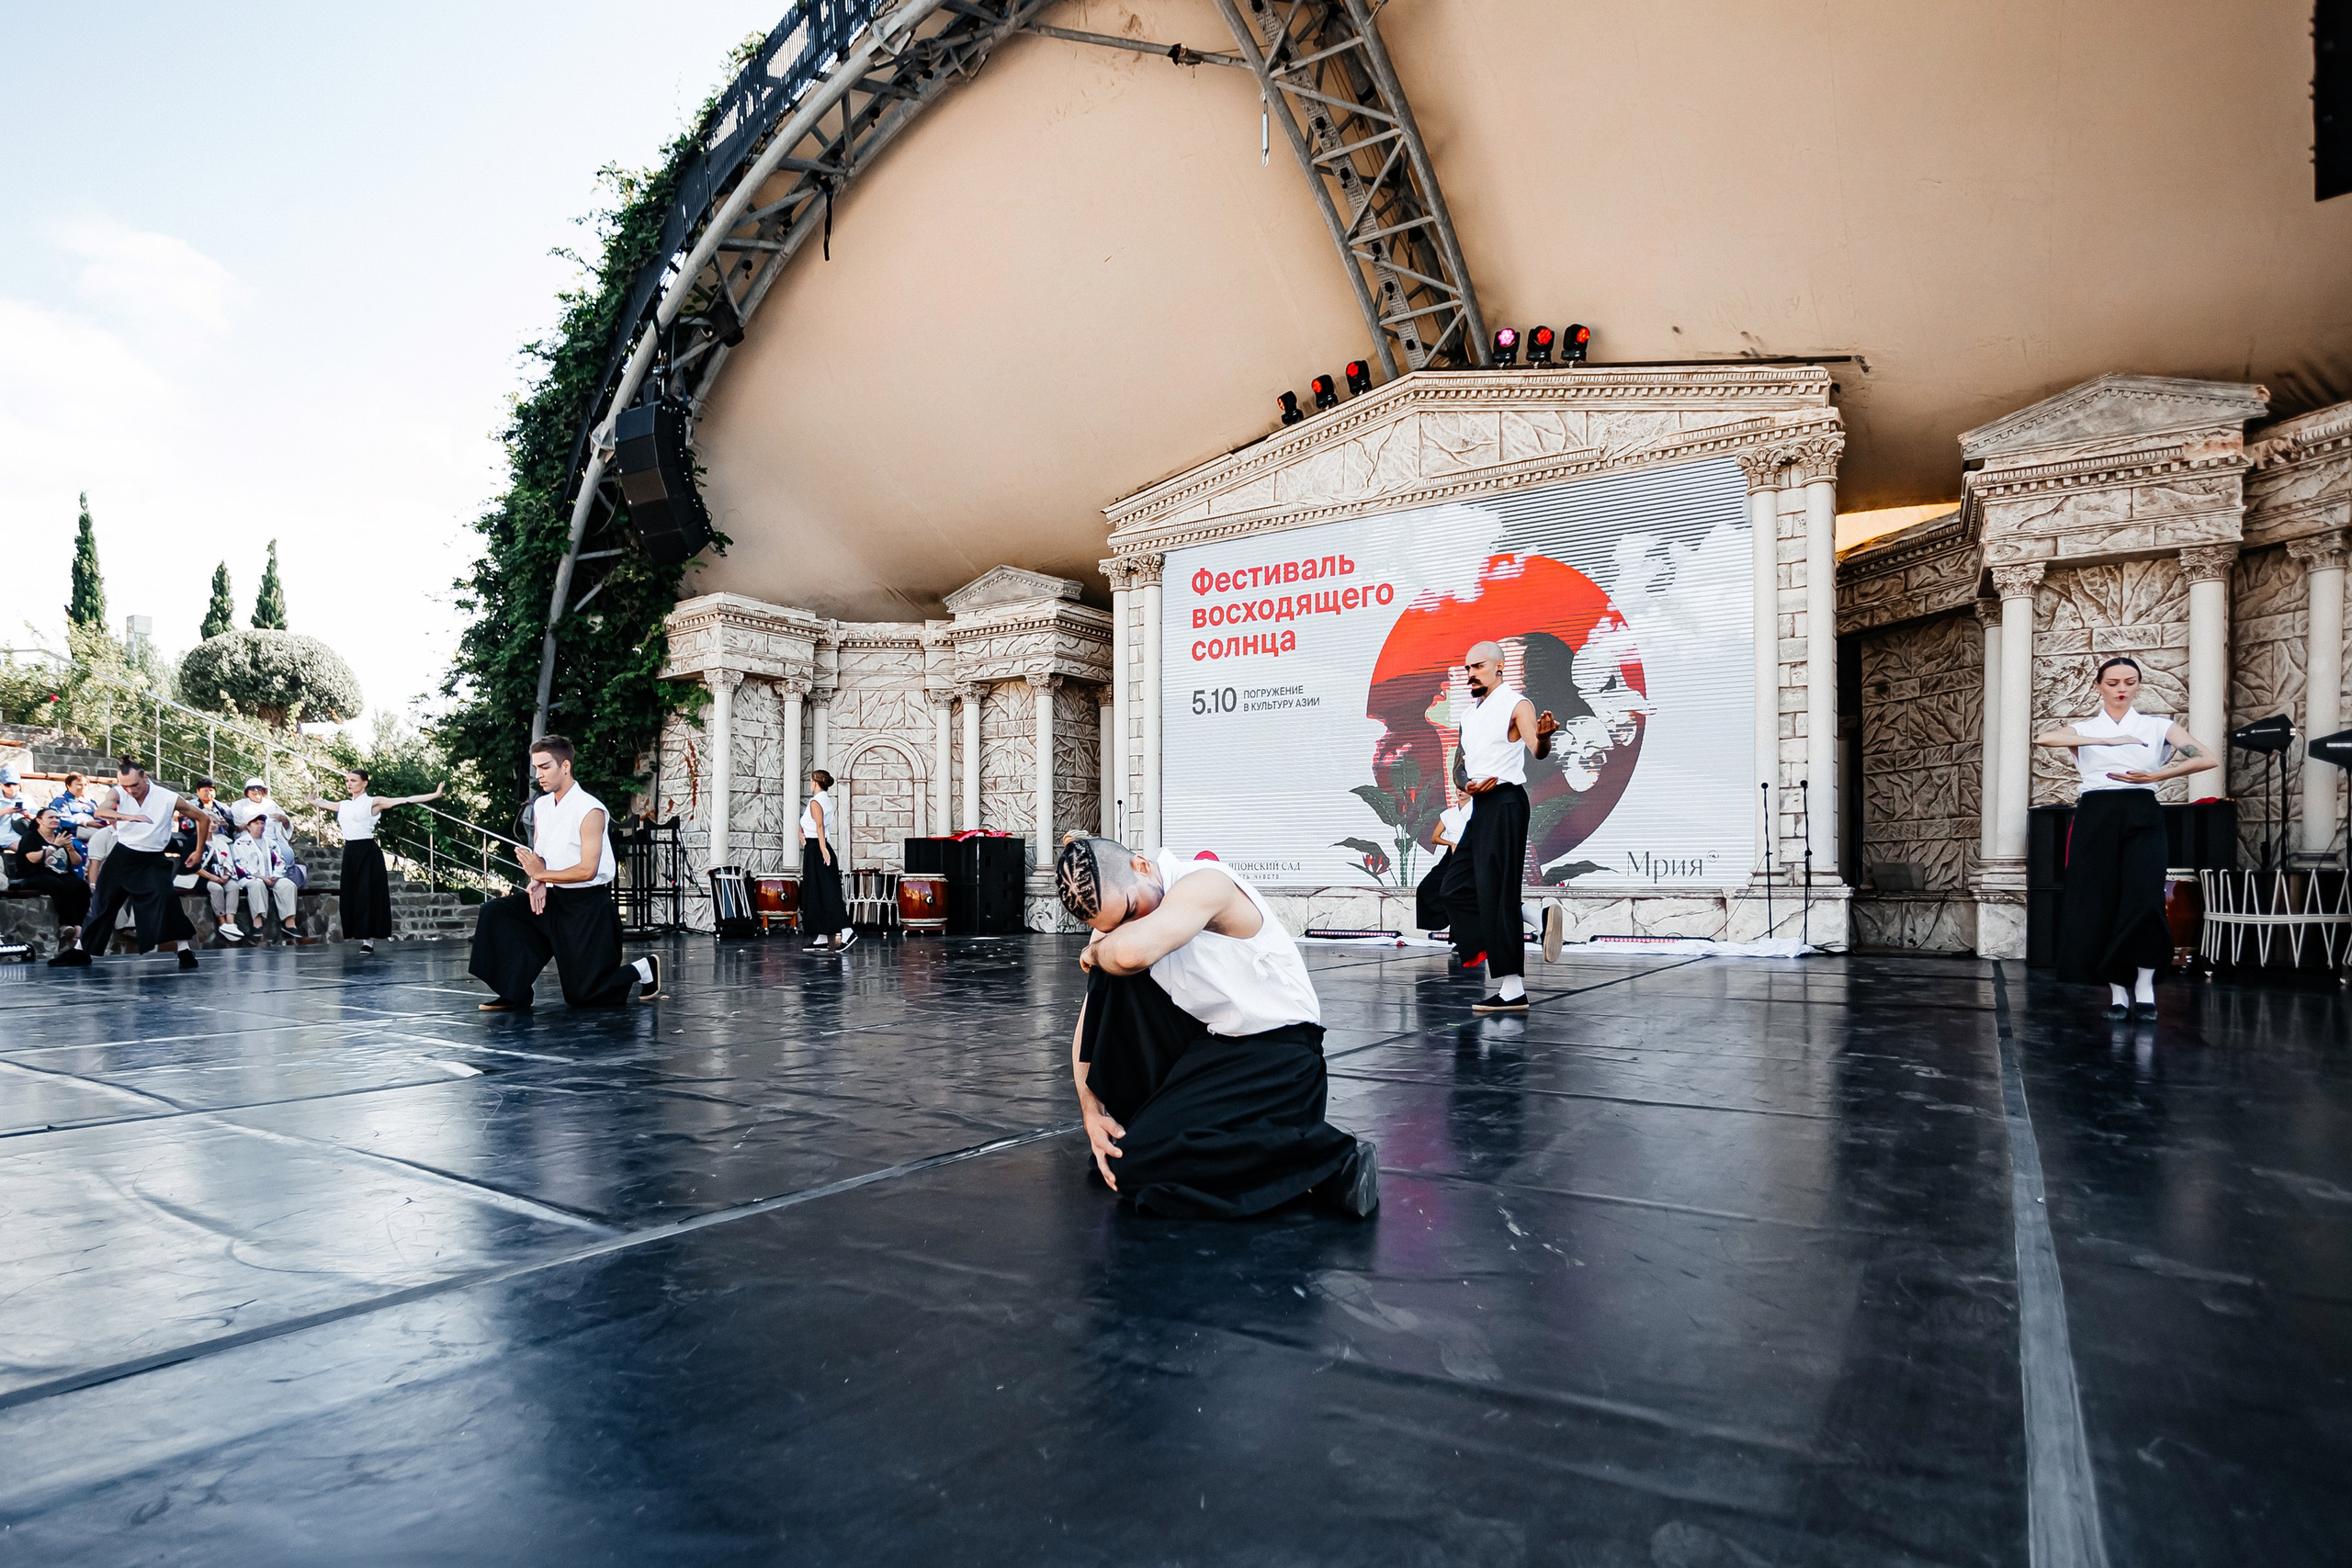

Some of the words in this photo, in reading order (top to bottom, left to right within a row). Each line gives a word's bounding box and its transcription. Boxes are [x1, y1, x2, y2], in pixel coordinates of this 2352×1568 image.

[1192, 554, 1355, 596] Фестиваль
[1192, 582, 1395, 629] восходящего
[1192, 629, 1296, 661] солнца
[1192, 686, 1238, 716] 5.10
[1243, 684, 1304, 699] ПОГРУЖЕНИЕ
[1243, 703, 1250, 712] В
[1250, 699, 1294, 712] КУЛЬТУРУ
[1295, 696, 1320, 708] АЗИИ
[1281, 862, 1301, 872] САД
[1627, 851, 1702, 885] Мрия
